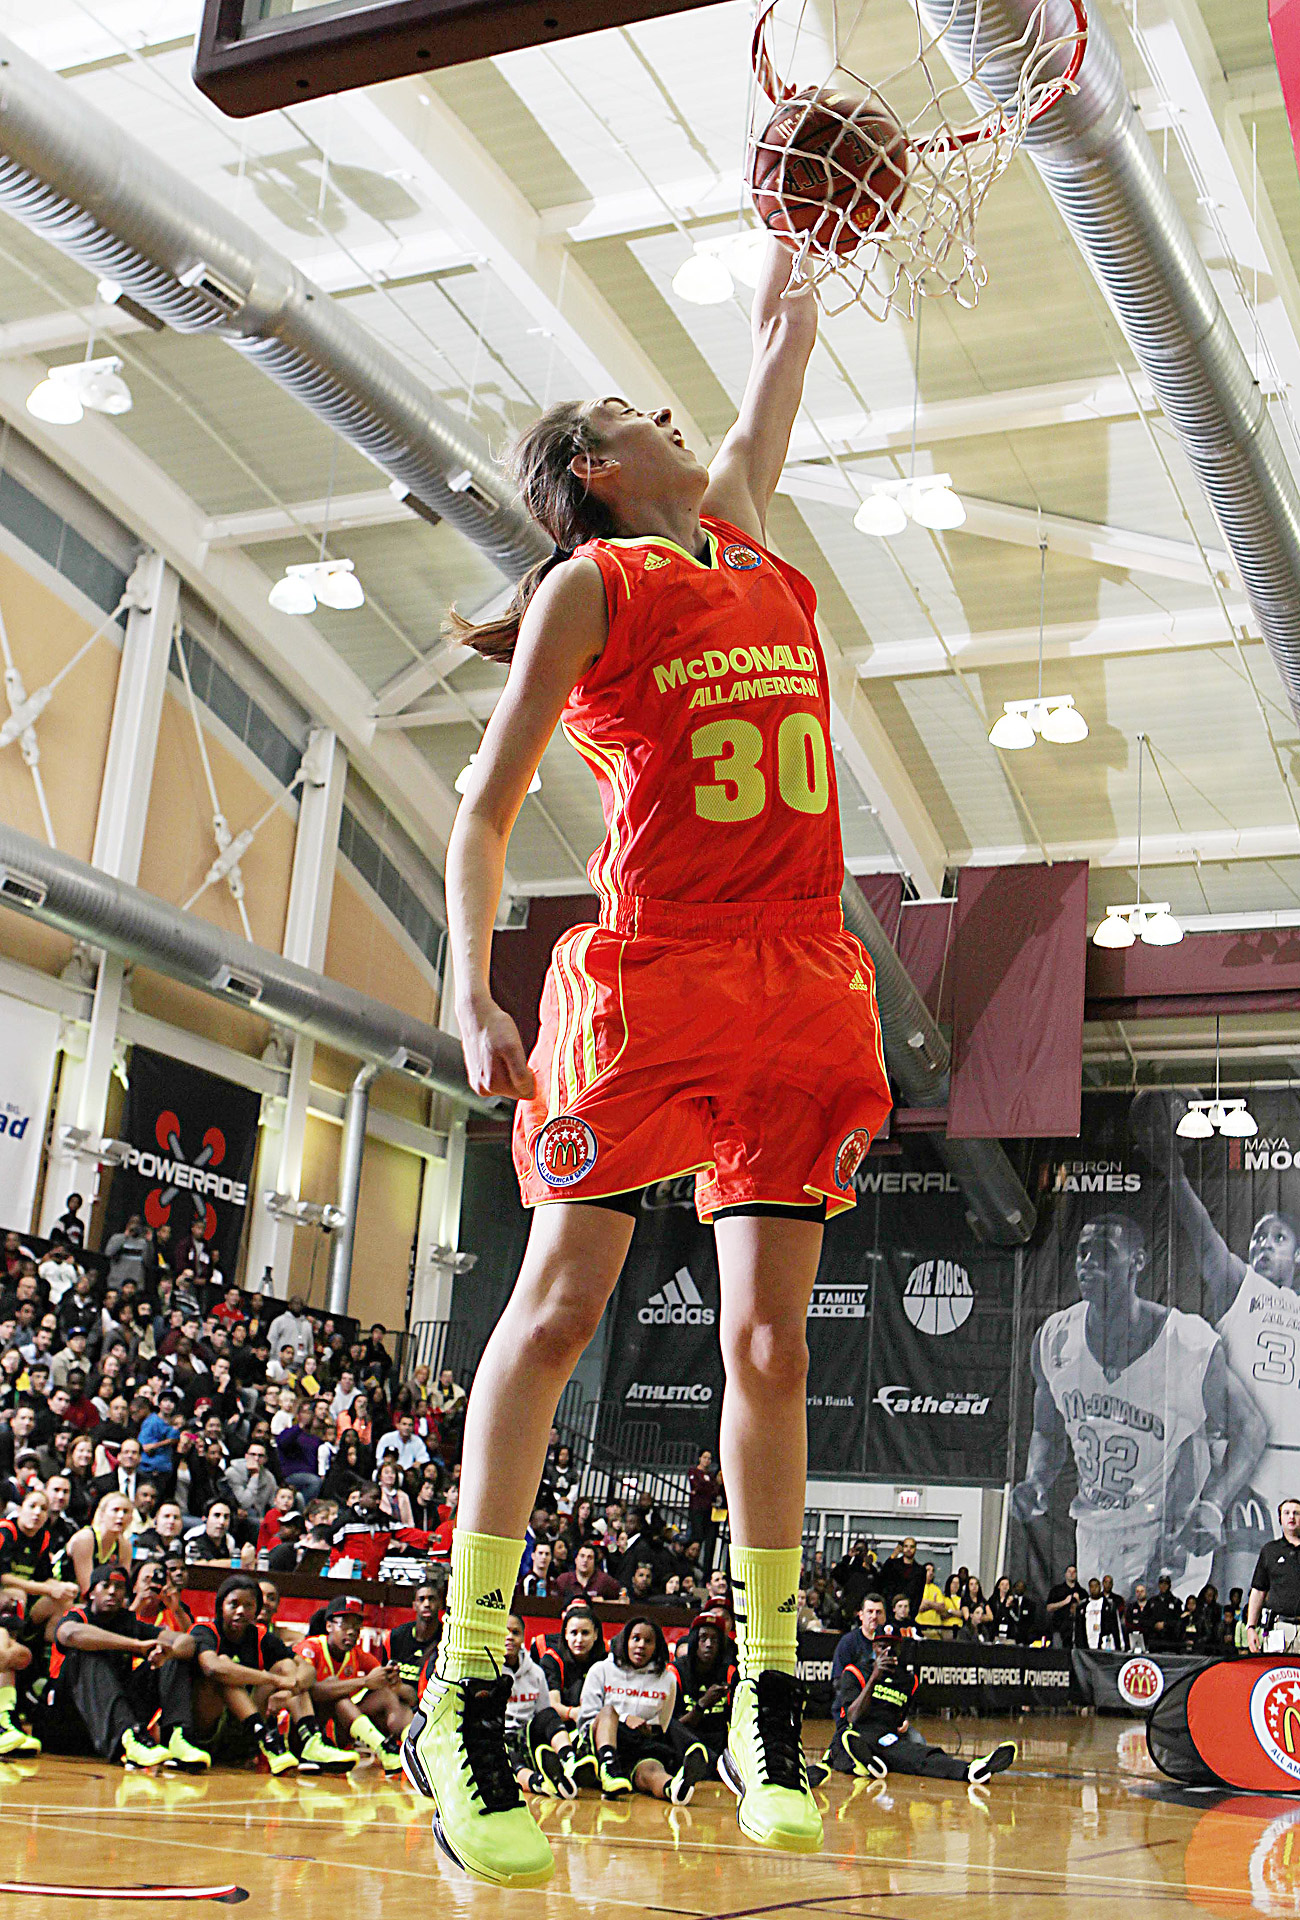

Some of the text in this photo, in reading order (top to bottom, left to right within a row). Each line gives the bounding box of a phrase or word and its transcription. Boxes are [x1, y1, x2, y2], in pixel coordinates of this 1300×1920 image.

[691, 712, 829, 823] 30
[1244, 1137, 1290, 1151] MAYA
[1053, 1160, 1122, 1174] LEBRON
[122, 1148, 247, 1207] POWERADE
[1051, 1173, 1142, 1193] JAMES
[904, 1260, 974, 1295] THE ROCK
[818, 1291, 866, 1304] FAMILY
[638, 1303, 715, 1325] adidas
[811, 1307, 855, 1315] ANCE
[1253, 1330, 1300, 1389] 3
[807, 1395, 855, 1407] ris Bank
[1077, 1424, 1140, 1497] 32
[919, 1665, 977, 1686] POWERADE
[1270, 1747, 1285, 1765] ALL
